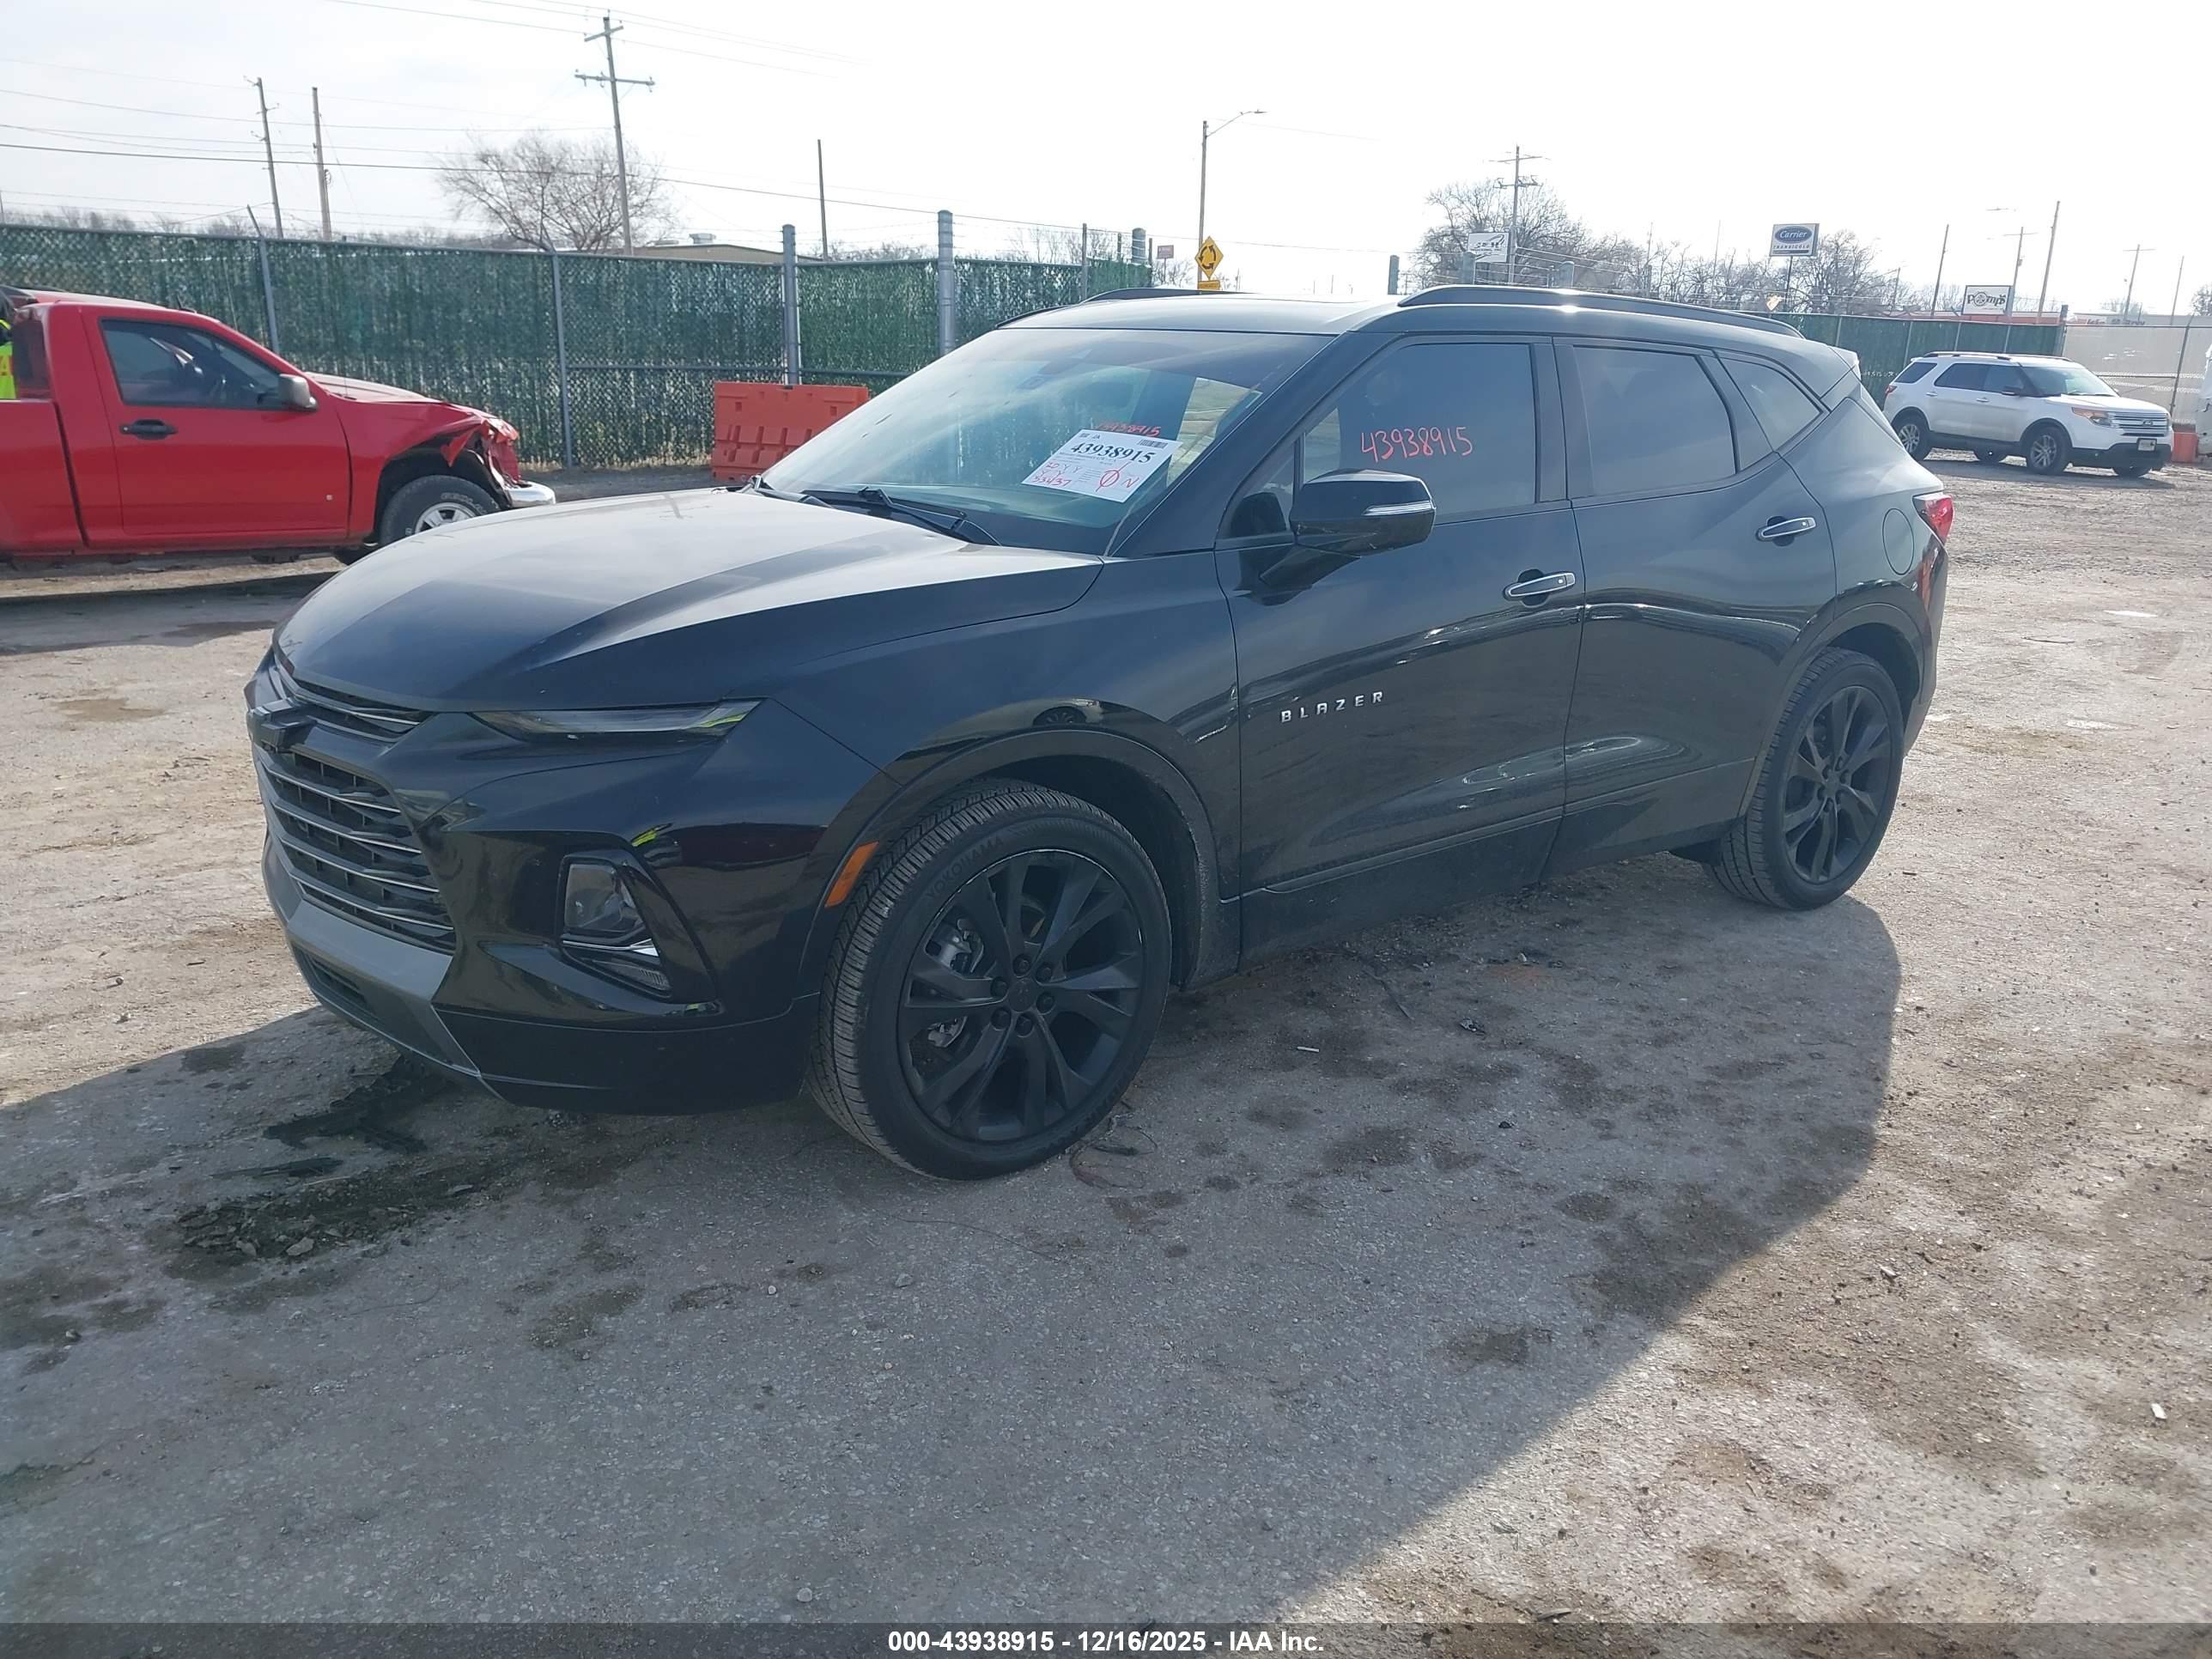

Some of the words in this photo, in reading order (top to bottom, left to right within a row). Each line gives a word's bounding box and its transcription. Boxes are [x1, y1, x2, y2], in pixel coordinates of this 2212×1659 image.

[1779, 230, 1808, 239] Carrier
[1071, 441, 1156, 464] 43938915
[1361, 427, 1473, 463] 43938915
[1280, 691, 1382, 723] BLAZER
